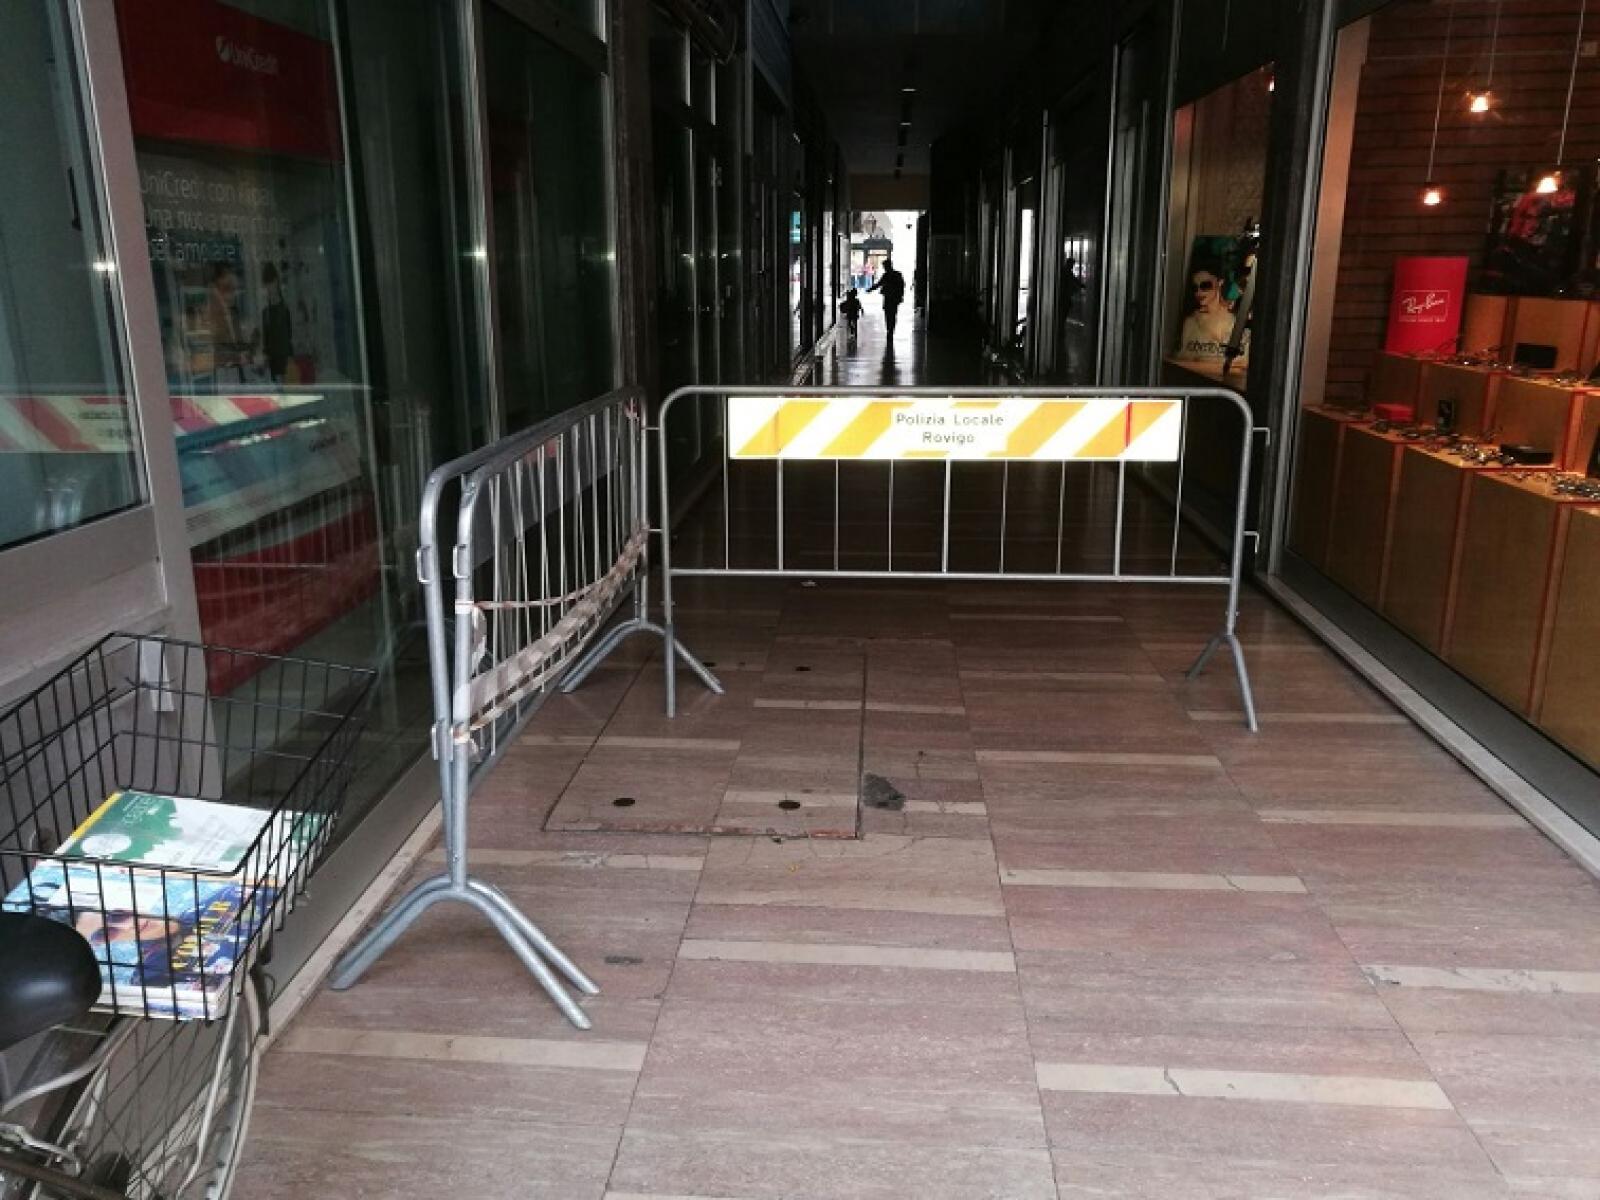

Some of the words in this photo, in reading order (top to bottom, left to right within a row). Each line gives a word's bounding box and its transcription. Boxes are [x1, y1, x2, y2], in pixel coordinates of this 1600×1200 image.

[896, 412, 945, 425] Polizia
[953, 413, 1005, 426] Locale
[922, 431, 975, 447] Rovigo
